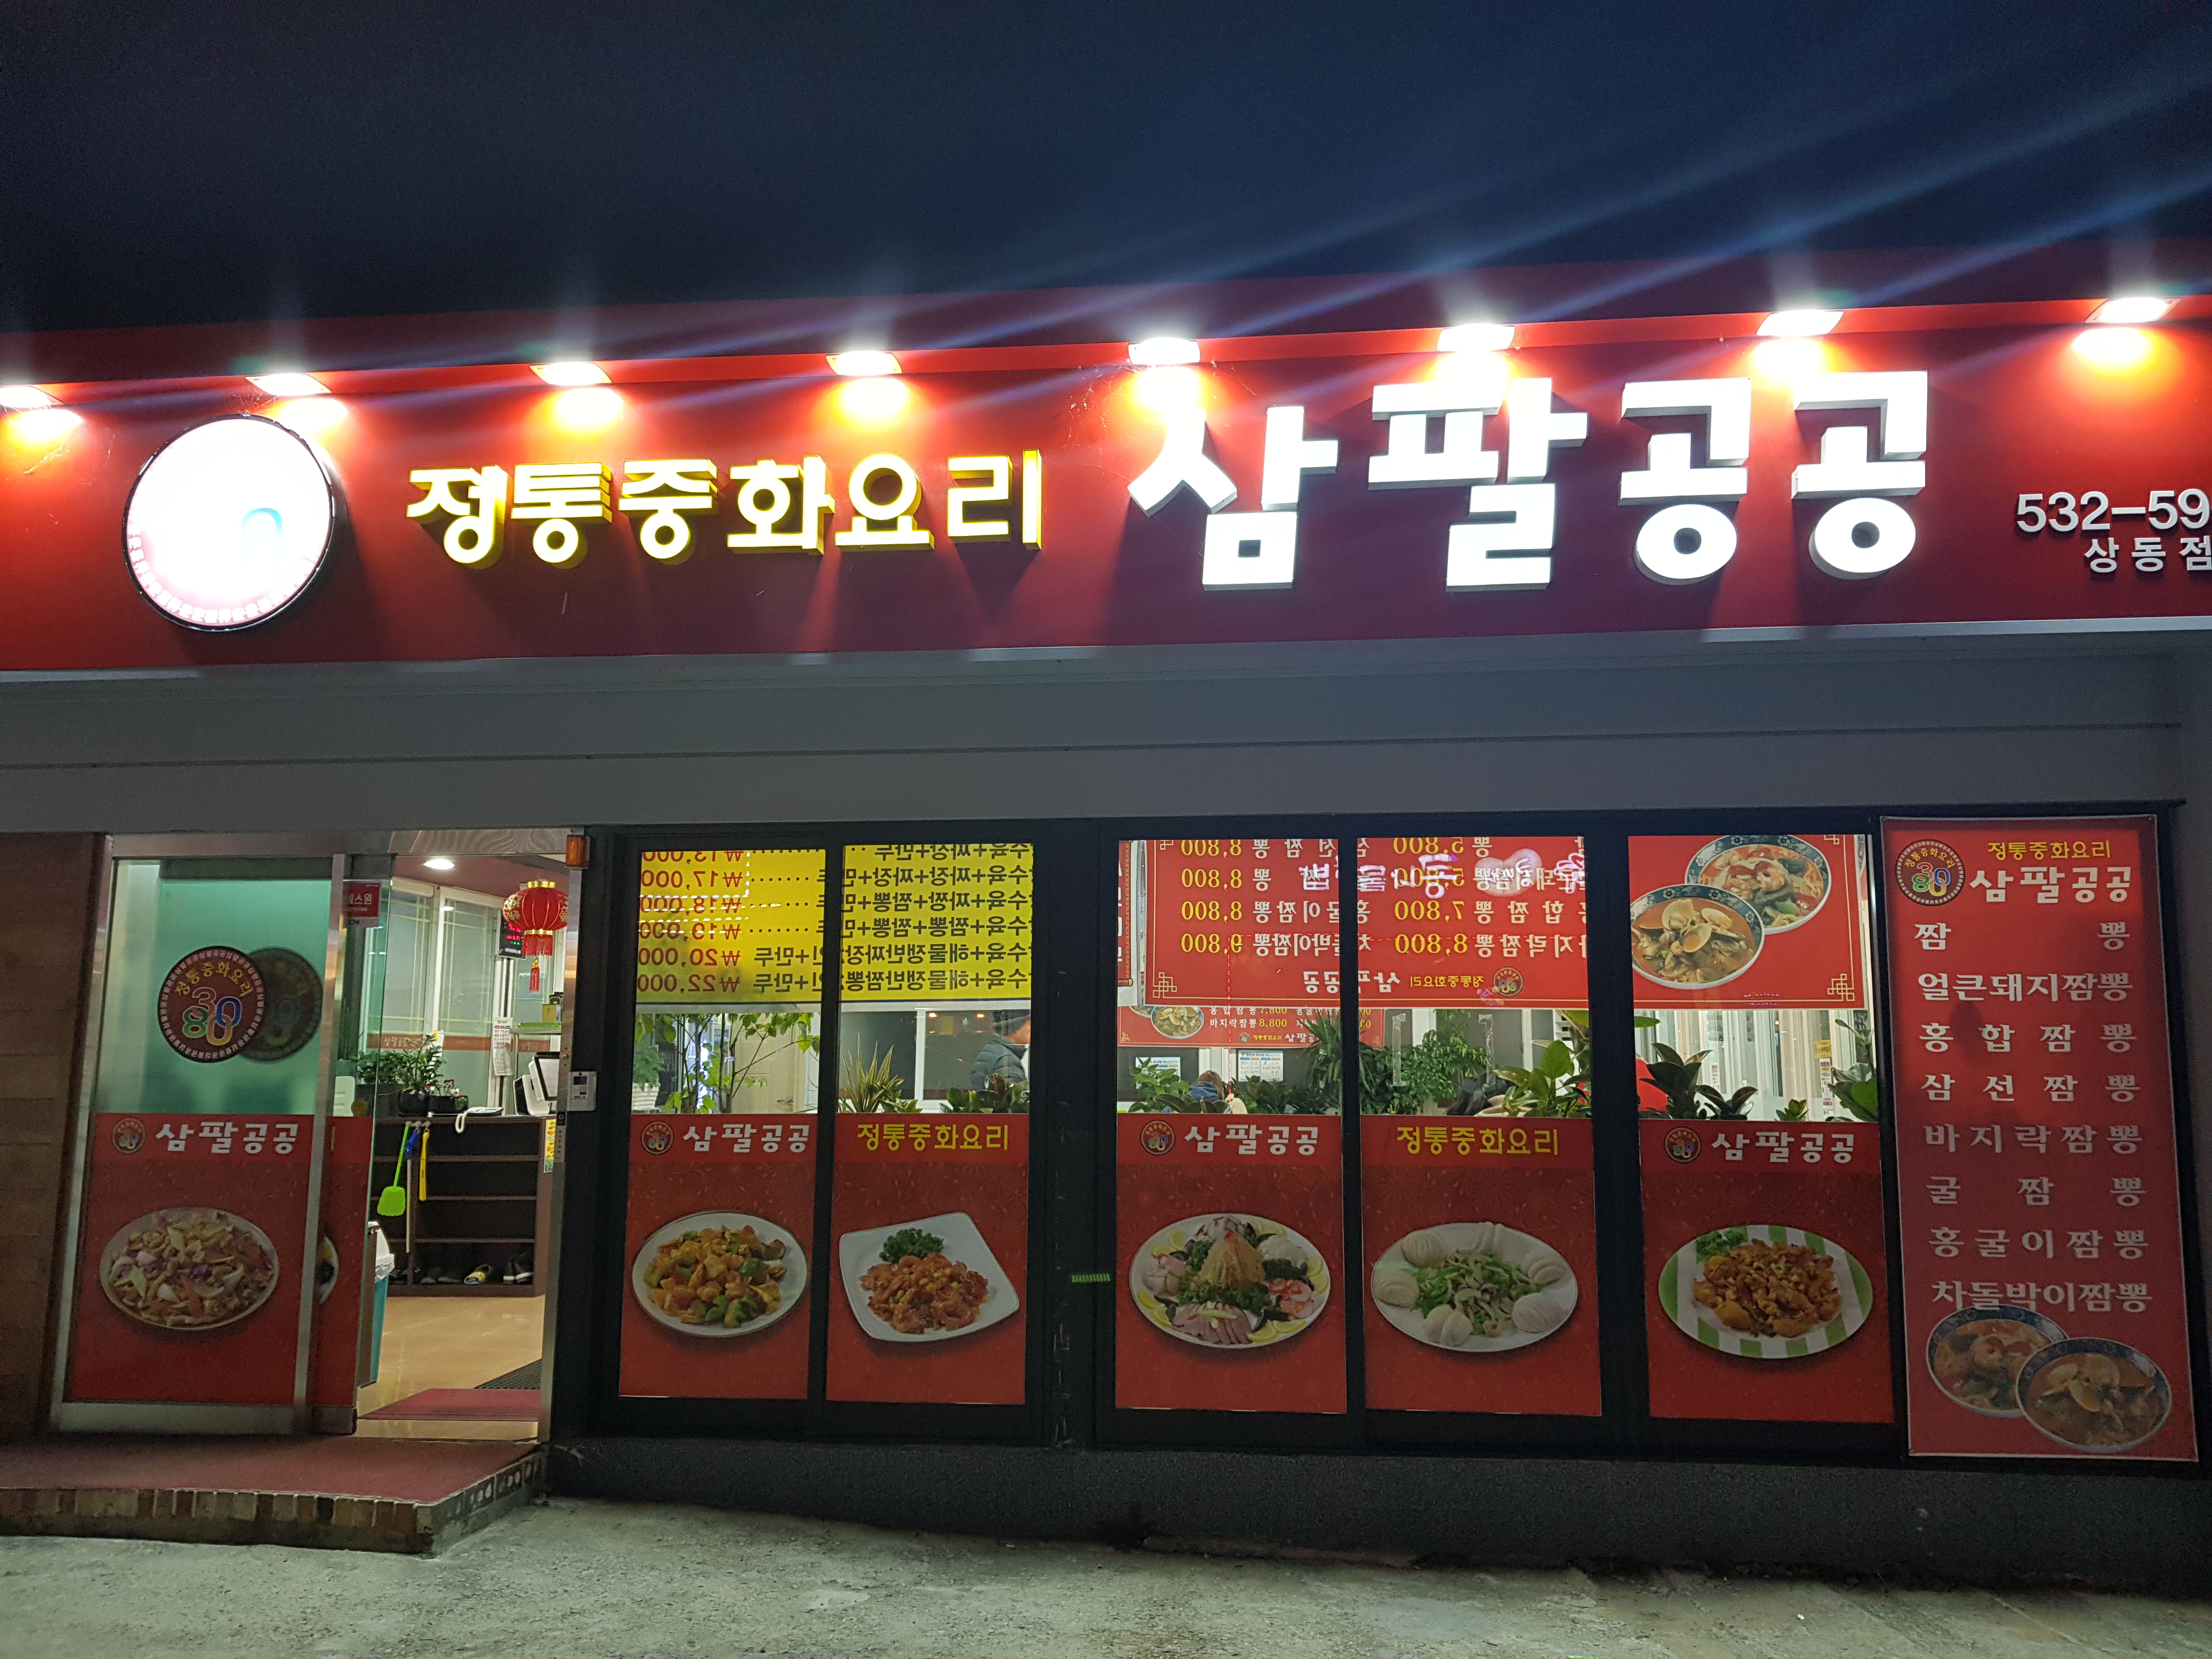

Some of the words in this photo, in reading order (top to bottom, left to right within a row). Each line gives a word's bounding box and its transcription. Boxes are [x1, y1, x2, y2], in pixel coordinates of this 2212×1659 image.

[1127, 370, 1929, 592] 삼팔공공
[407, 449, 1043, 566] 정통중화요리
[2084, 535, 2212, 573] 상동점
[1988, 840, 2111, 860] 정통중화요리
[1970, 866, 2131, 904] 삼팔공공
[175, 962, 253, 997] 정통중화요리
[1918, 973, 2134, 1002] 얼큰돼지짬뽕
[1259, 1018, 1288, 1028] 8,800
[155, 1122, 298, 1154] 삼팔공공
[682, 1124, 810, 1153] 삼팔공공
[857, 1124, 1008, 1151] 정통중화요리
[1184, 1124, 1318, 1155] 삼팔공공
[1397, 1126, 1558, 1155] 정통중화요리
[1711, 1131, 1854, 1164] 삼팔공공
[1932, 1280, 2153, 1313] 차돌박이짬뽕
